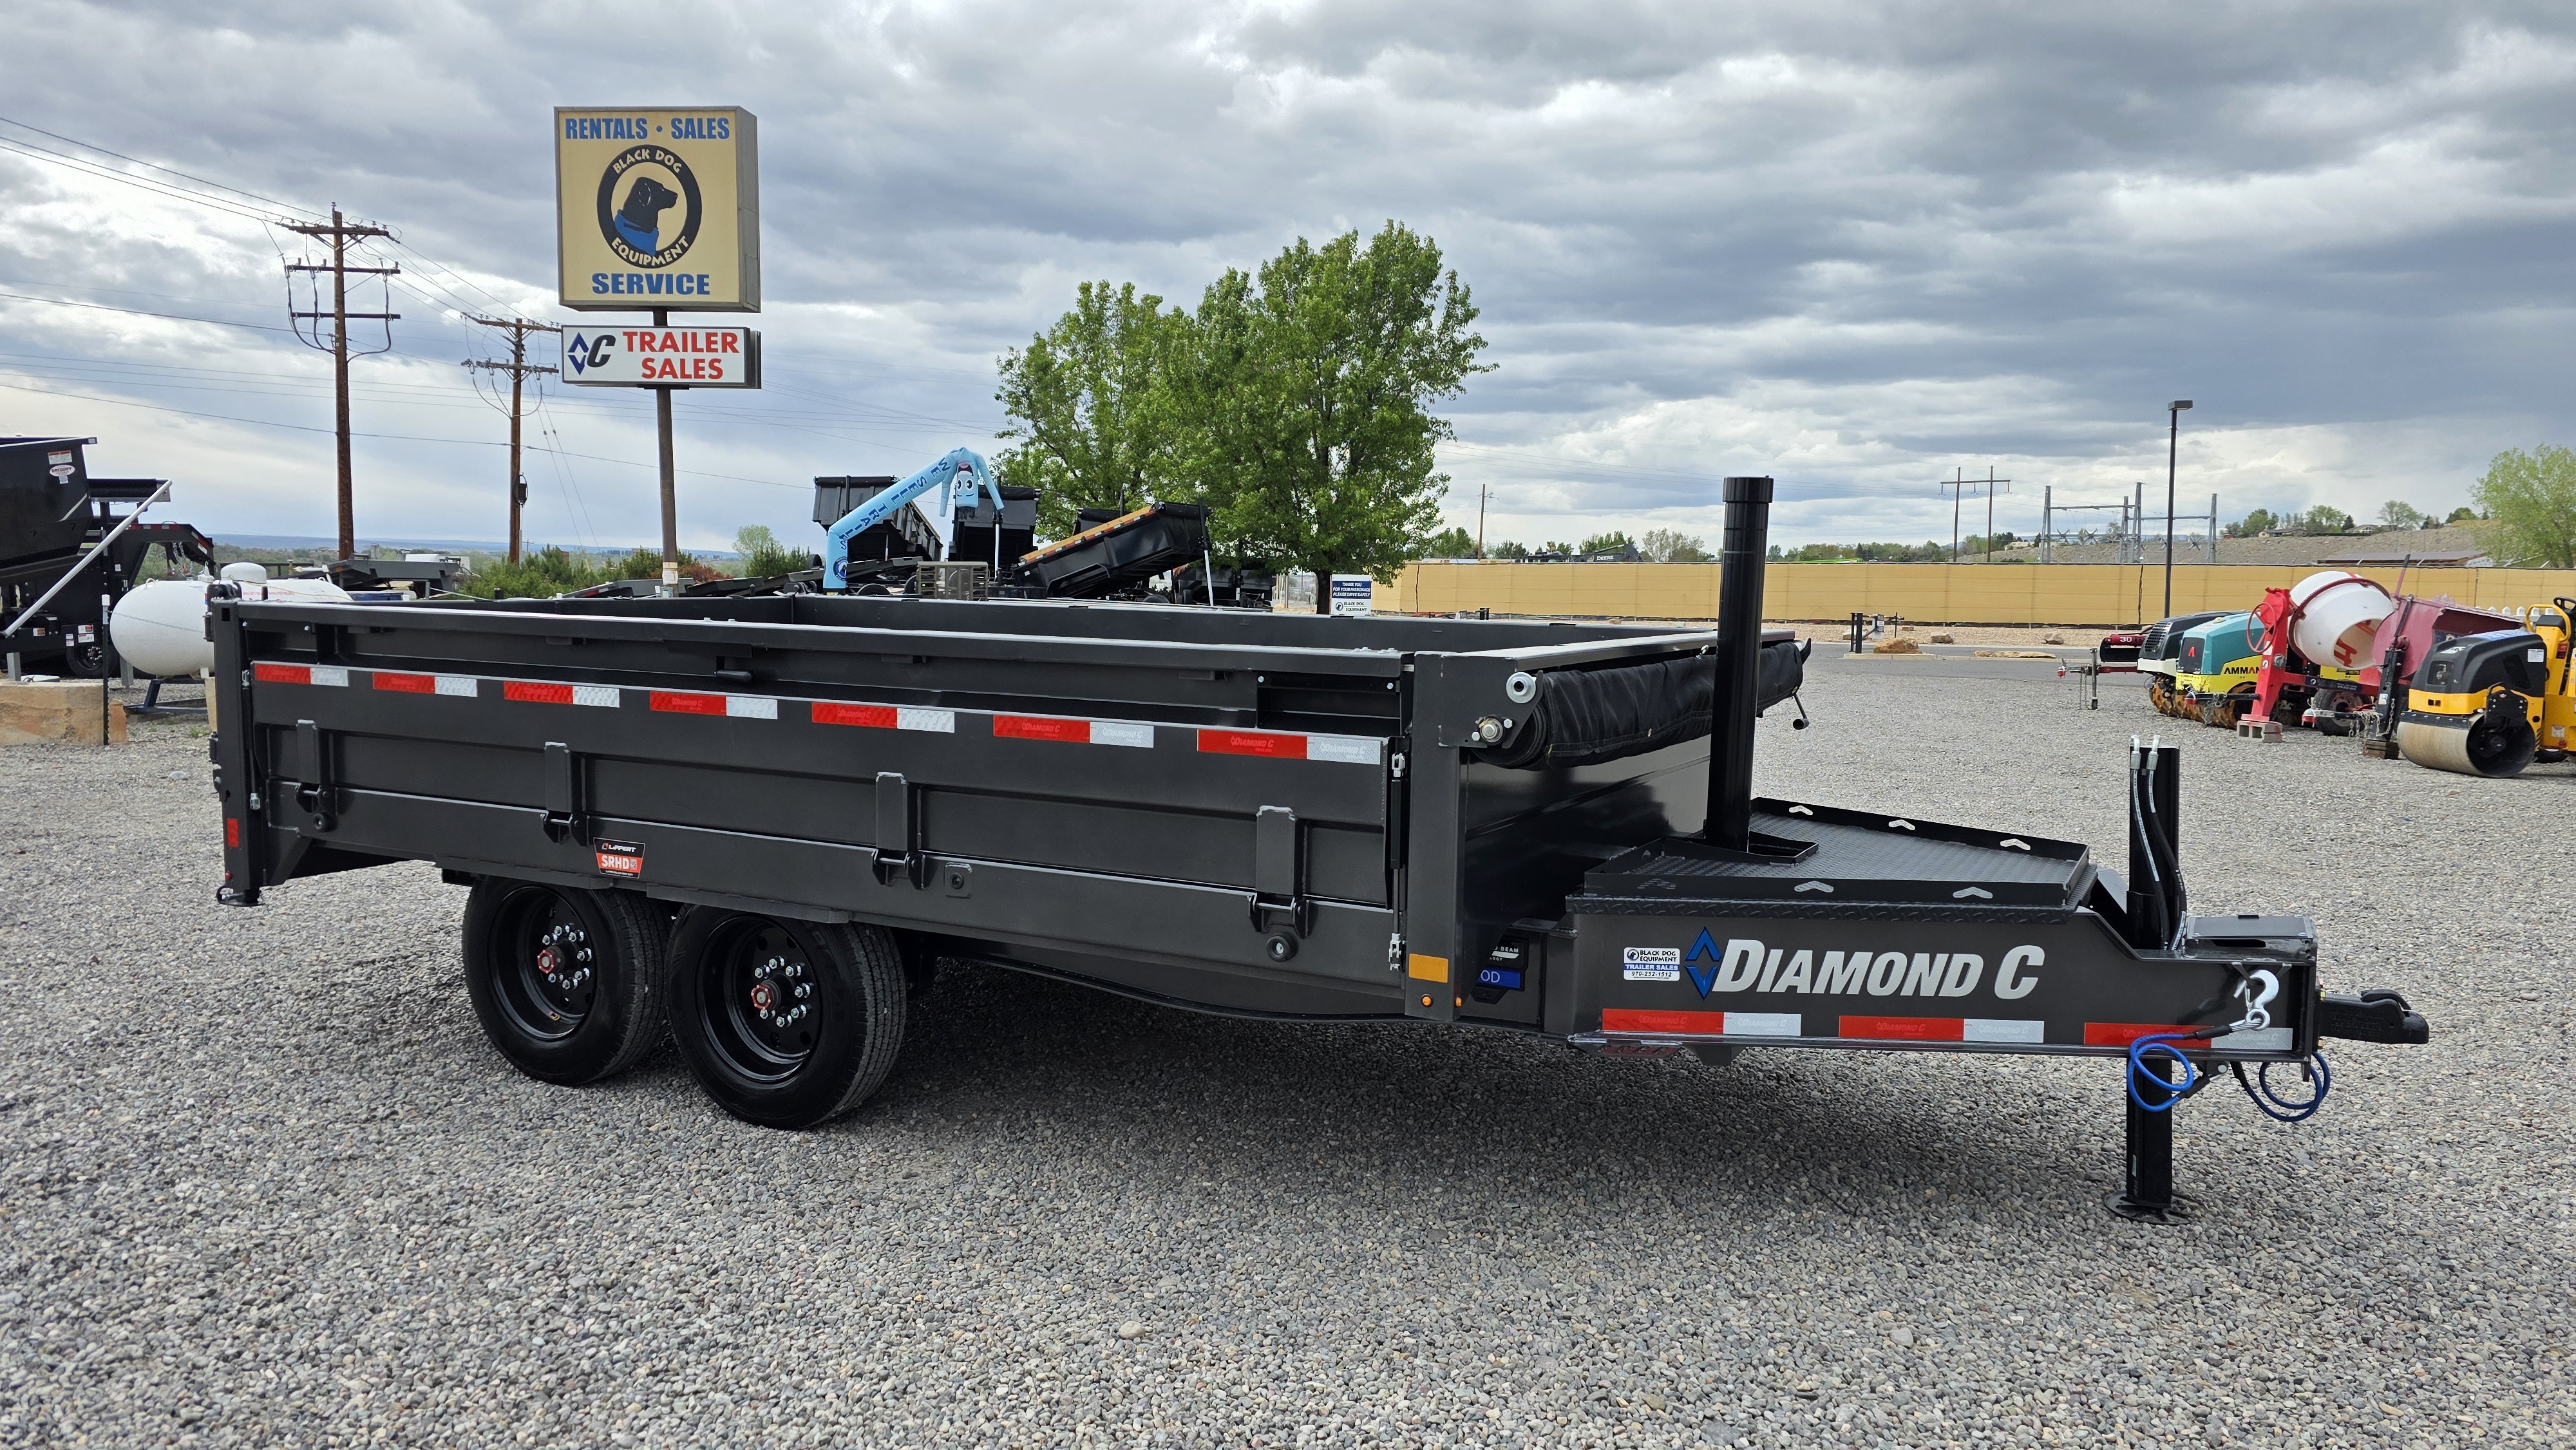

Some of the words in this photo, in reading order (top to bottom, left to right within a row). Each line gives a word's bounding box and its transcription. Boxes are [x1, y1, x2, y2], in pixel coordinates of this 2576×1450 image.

[565, 118, 648, 140] RENTALS
[670, 117, 730, 140] SALES
[612, 149, 650, 174] BLACK
[655, 149, 682, 174] DOG
[611, 235, 689, 267] EQUIPMENT
[591, 272, 710, 295] SERVICE
[586, 334, 616, 368] C
[622, 331, 740, 353] TRAILER
[641, 357, 723, 379] SALES
[930, 457, 951, 478] WE
[891, 476, 927, 504] SELL
[1235, 737, 1267, 748] DIAMOND
[601, 854, 629, 870] SRHD
[1480, 969, 1501, 983] OD
[1711, 939, 1984, 997] DIAMOND
[1994, 945, 2045, 1000] C
[1881, 1022, 1917, 1032] DIAMOND
